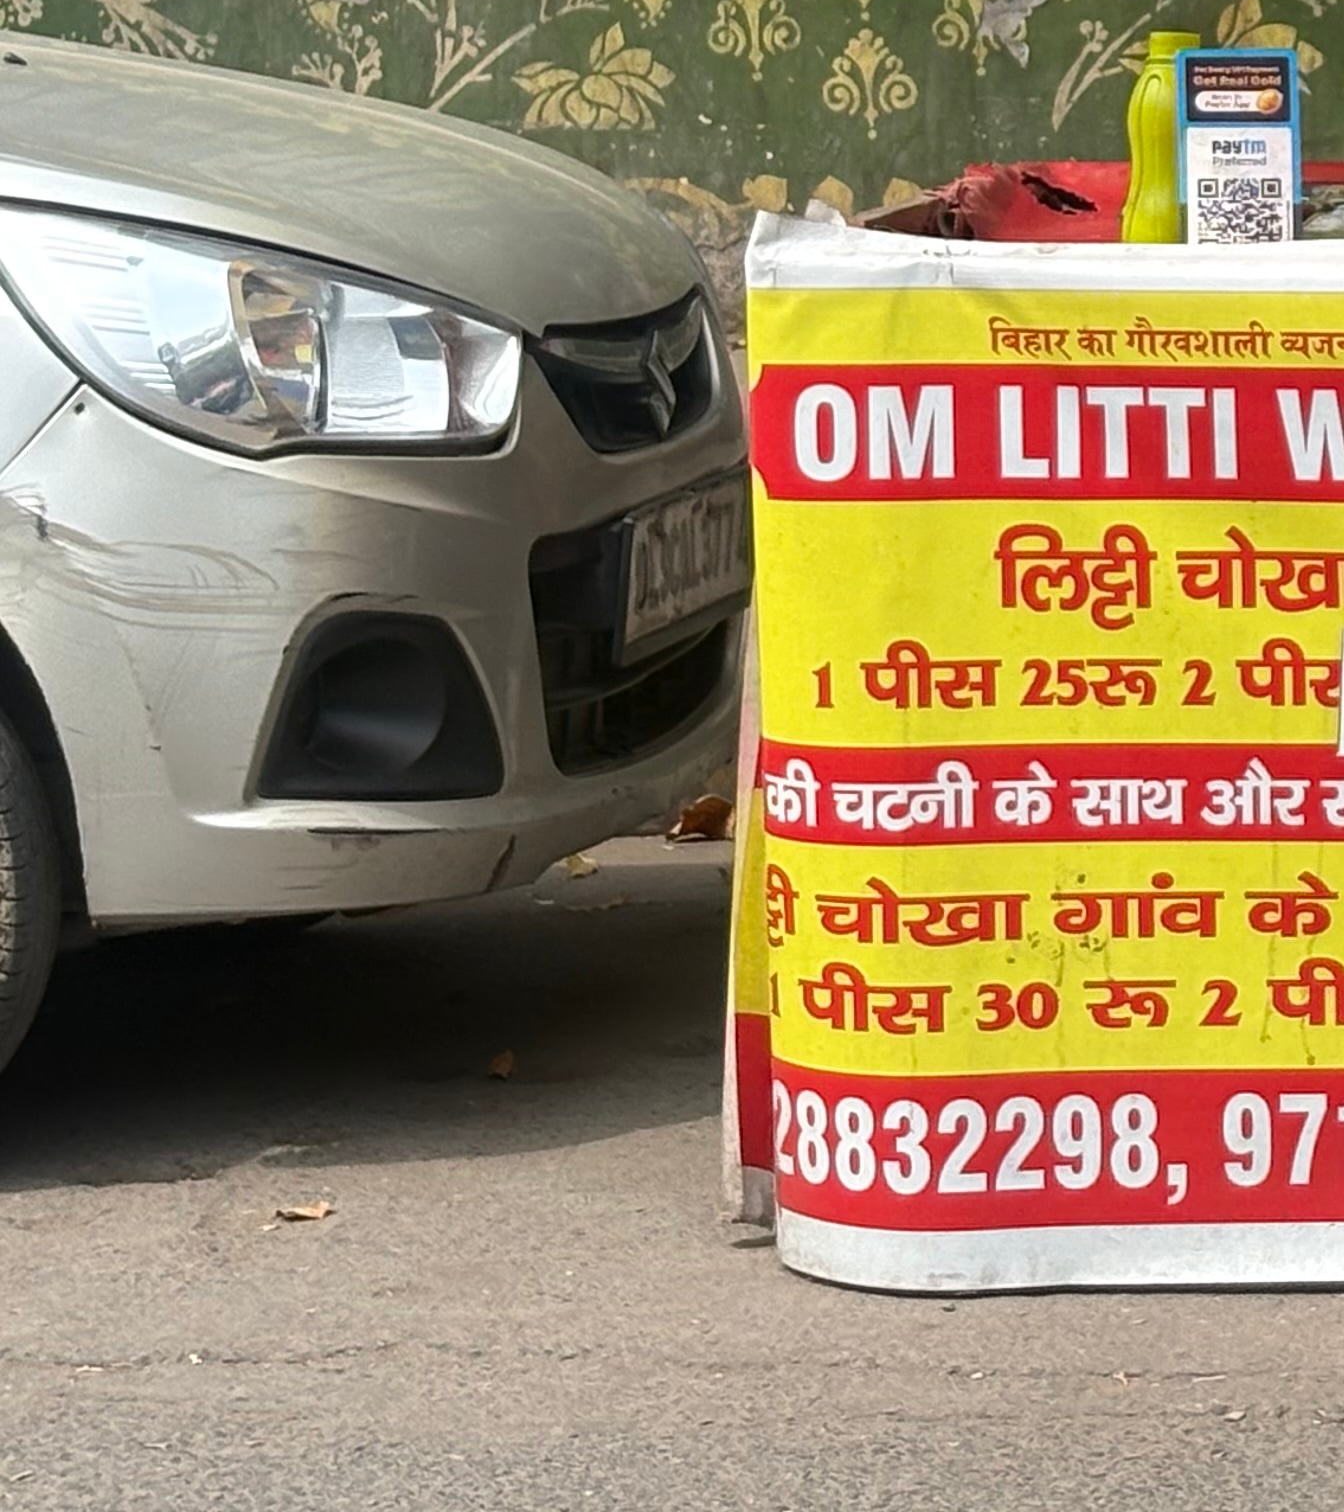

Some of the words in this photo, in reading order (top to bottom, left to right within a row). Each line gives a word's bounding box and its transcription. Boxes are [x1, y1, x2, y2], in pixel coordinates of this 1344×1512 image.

[1212, 157, 1267, 166] Preferred
[988, 316, 1071, 360] बिहार
[1077, 328, 1116, 359] का
[1124, 316, 1272, 361] गौरवशाली
[794, 384, 955, 482] OM
[999, 385, 1238, 480] LITTI
[994, 524, 1158, 631] लिट्टी
[812, 662, 834, 708] 1
[861, 639, 1002, 709] पीस
[1184, 660, 1216, 707] 2
[766, 759, 819, 829] की
[833, 761, 978, 831] चटनी
[993, 762, 1057, 826] के
[1072, 779, 1186, 827] साथ
[1201, 758, 1310, 826] और
[815, 877, 1030, 947] चोखा
[1051, 872, 1225, 939] गांव
[1245, 871, 1338, 938] के
[798, 962, 952, 1035] पीस
[977, 983, 1059, 1031] 30
[1084, 980, 1176, 1028] रू
[1199, 981, 1242, 1027] 2
